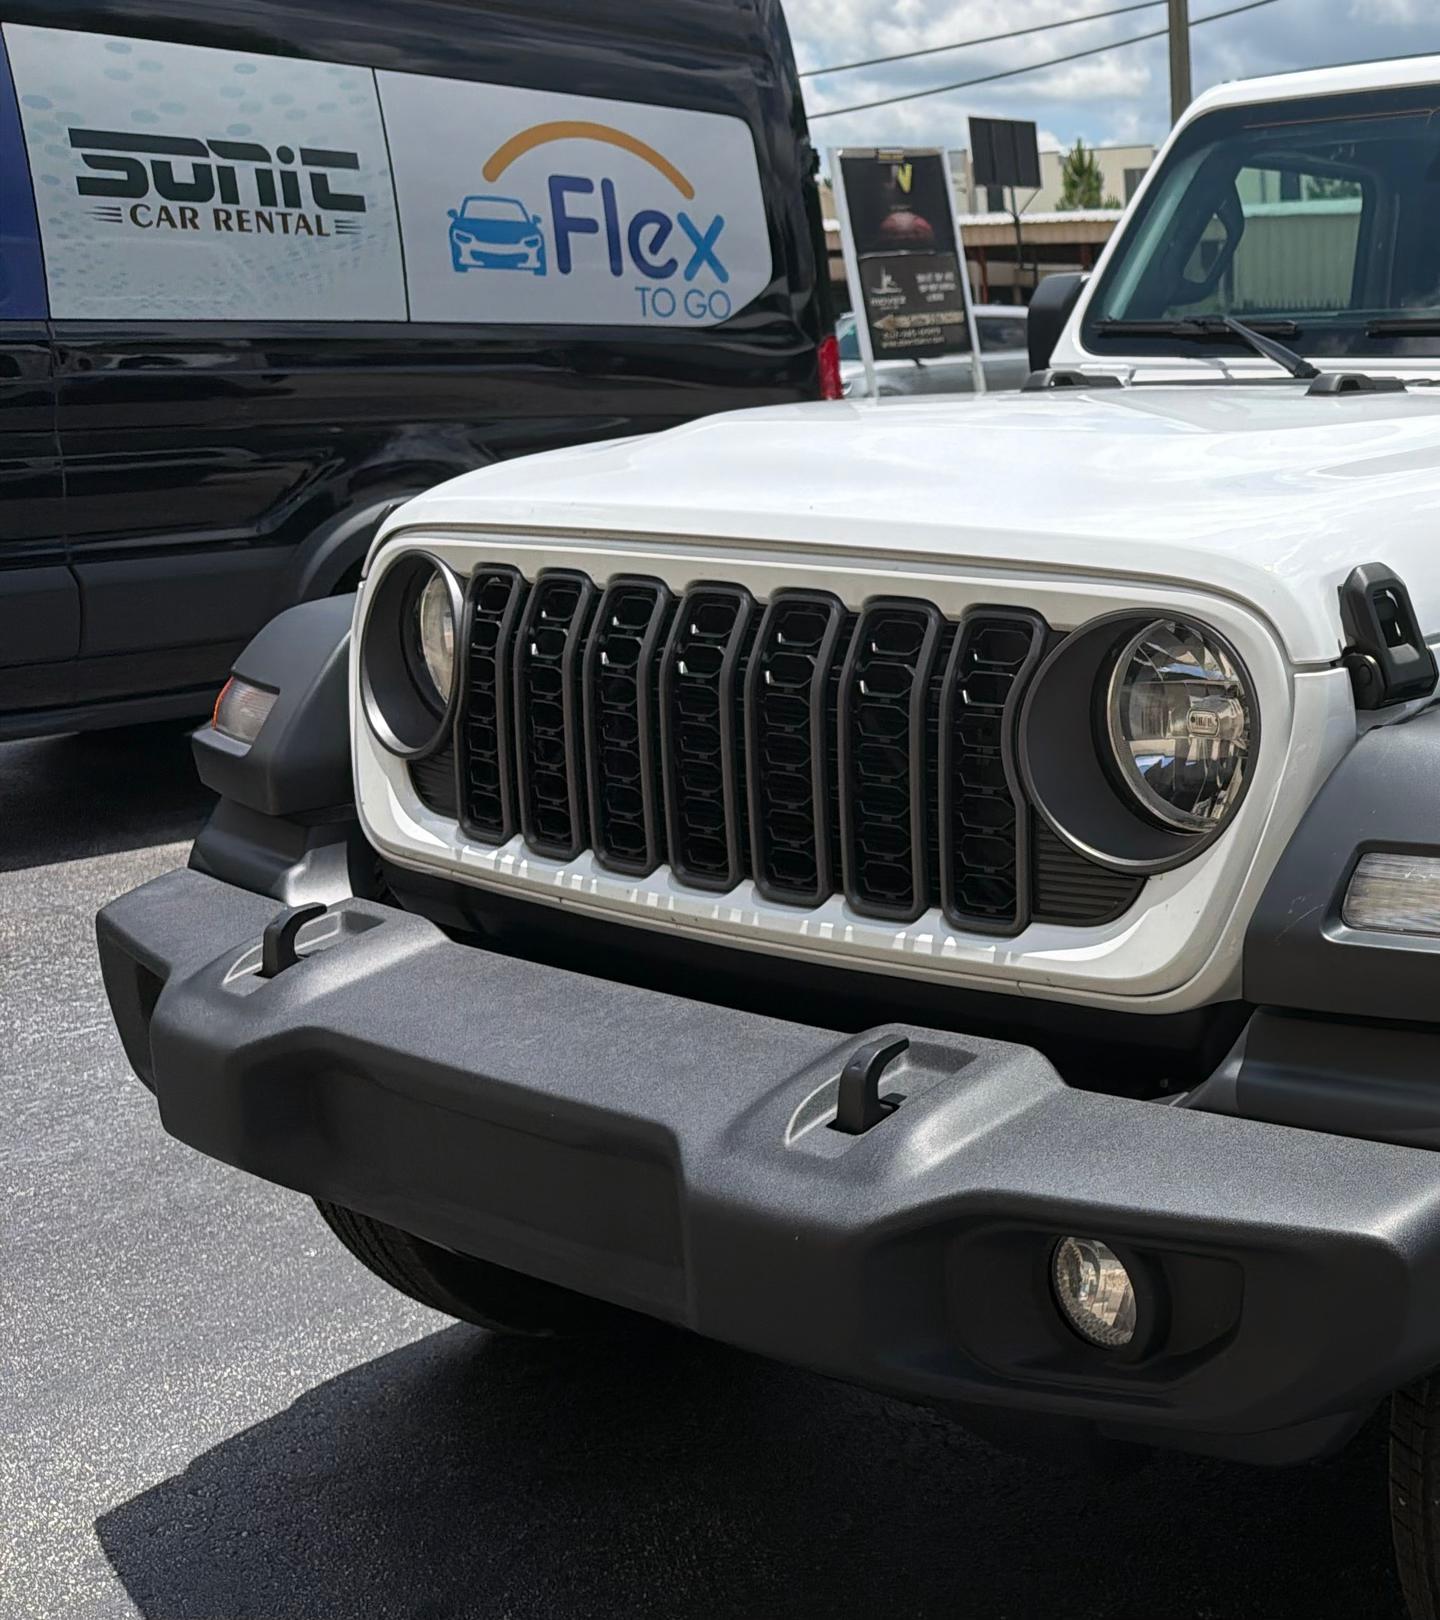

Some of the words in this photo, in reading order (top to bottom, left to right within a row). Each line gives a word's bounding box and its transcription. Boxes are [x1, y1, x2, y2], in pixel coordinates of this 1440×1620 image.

[129, 203, 200, 230] CAR
[212, 207, 331, 237] RENTAL
[548, 174, 730, 284] Flex
[634, 286, 677, 318] TO
[683, 289, 732, 319] GO
